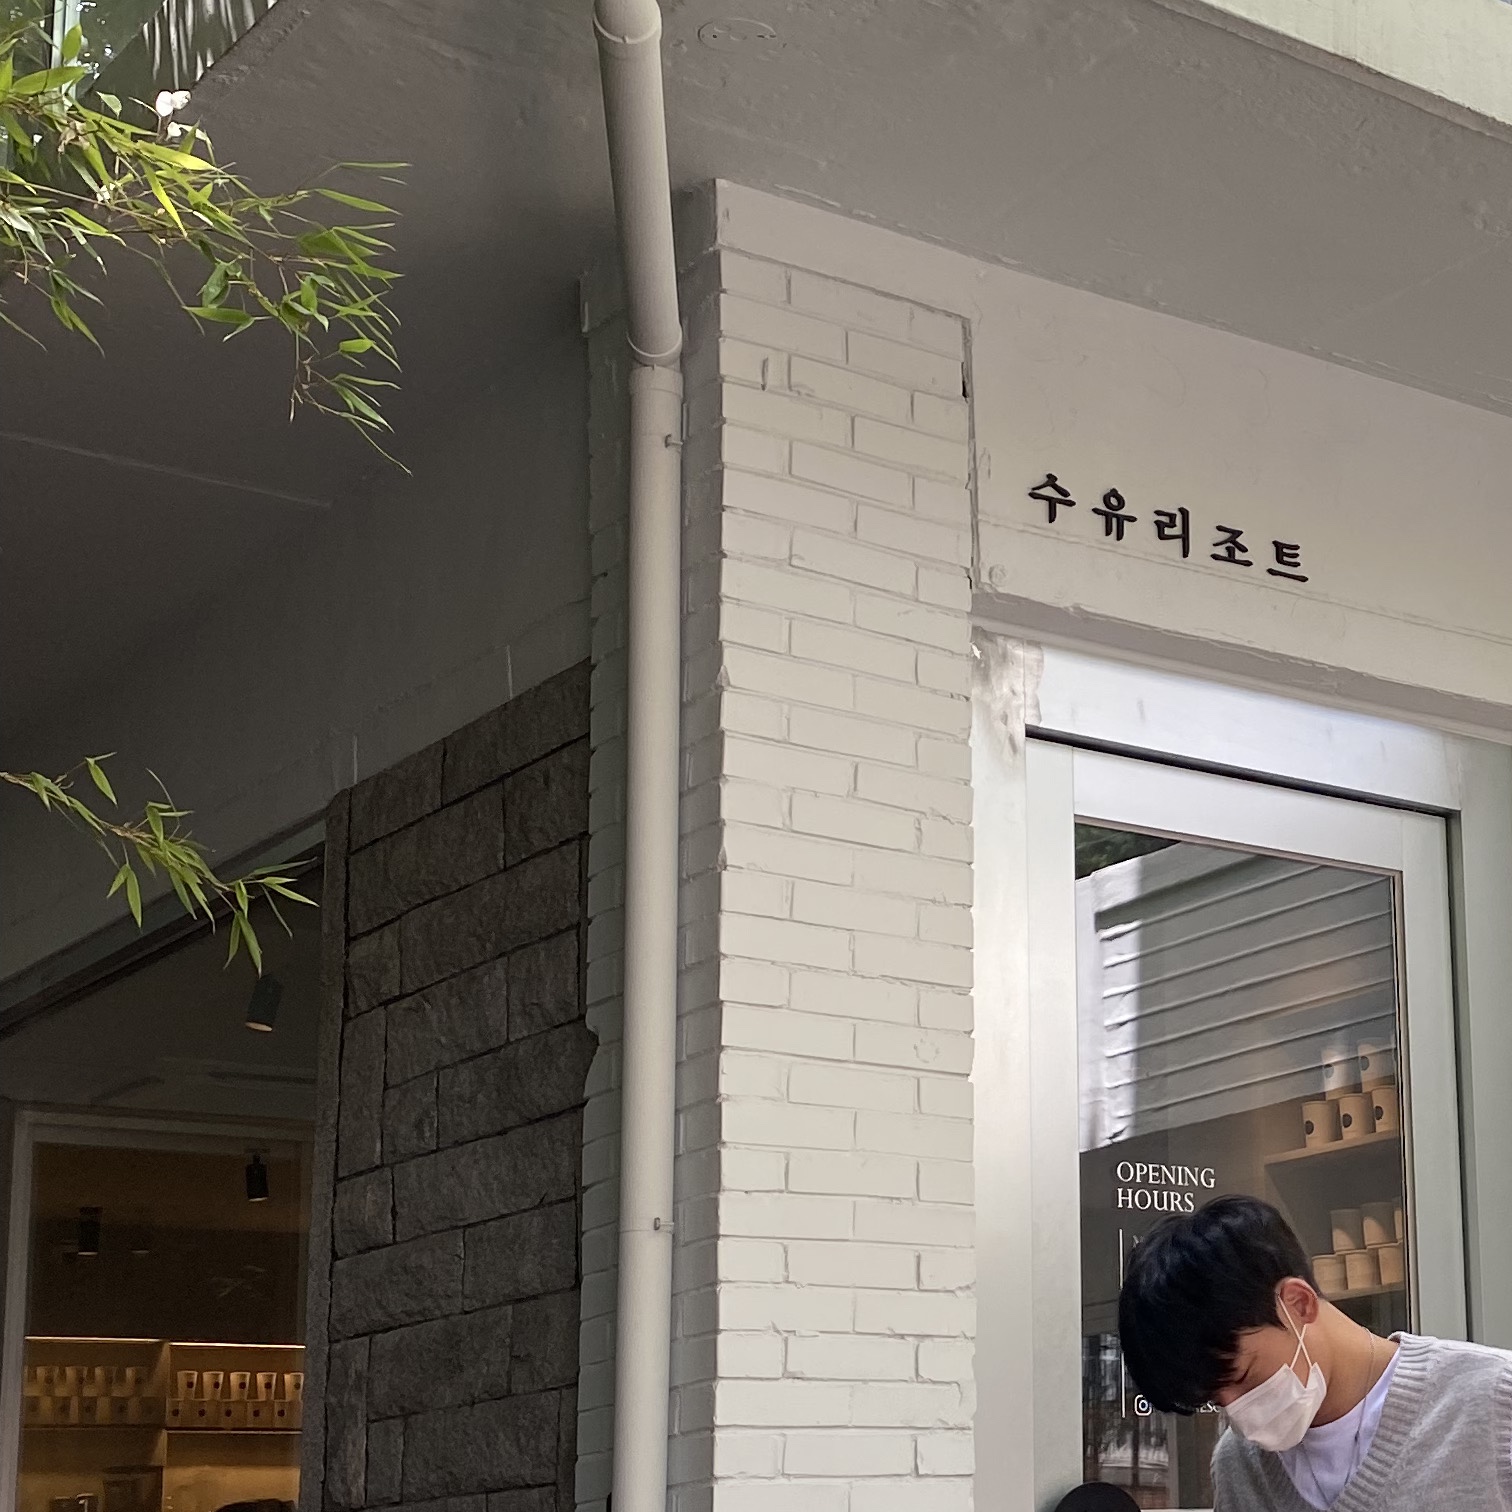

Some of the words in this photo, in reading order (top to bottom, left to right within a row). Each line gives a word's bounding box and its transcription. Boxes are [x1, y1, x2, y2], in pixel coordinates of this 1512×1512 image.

[1028, 473, 1309, 583] 수유리조트
[1116, 1161, 1216, 1188] OPENING
[1116, 1188, 1195, 1213] HOURS
